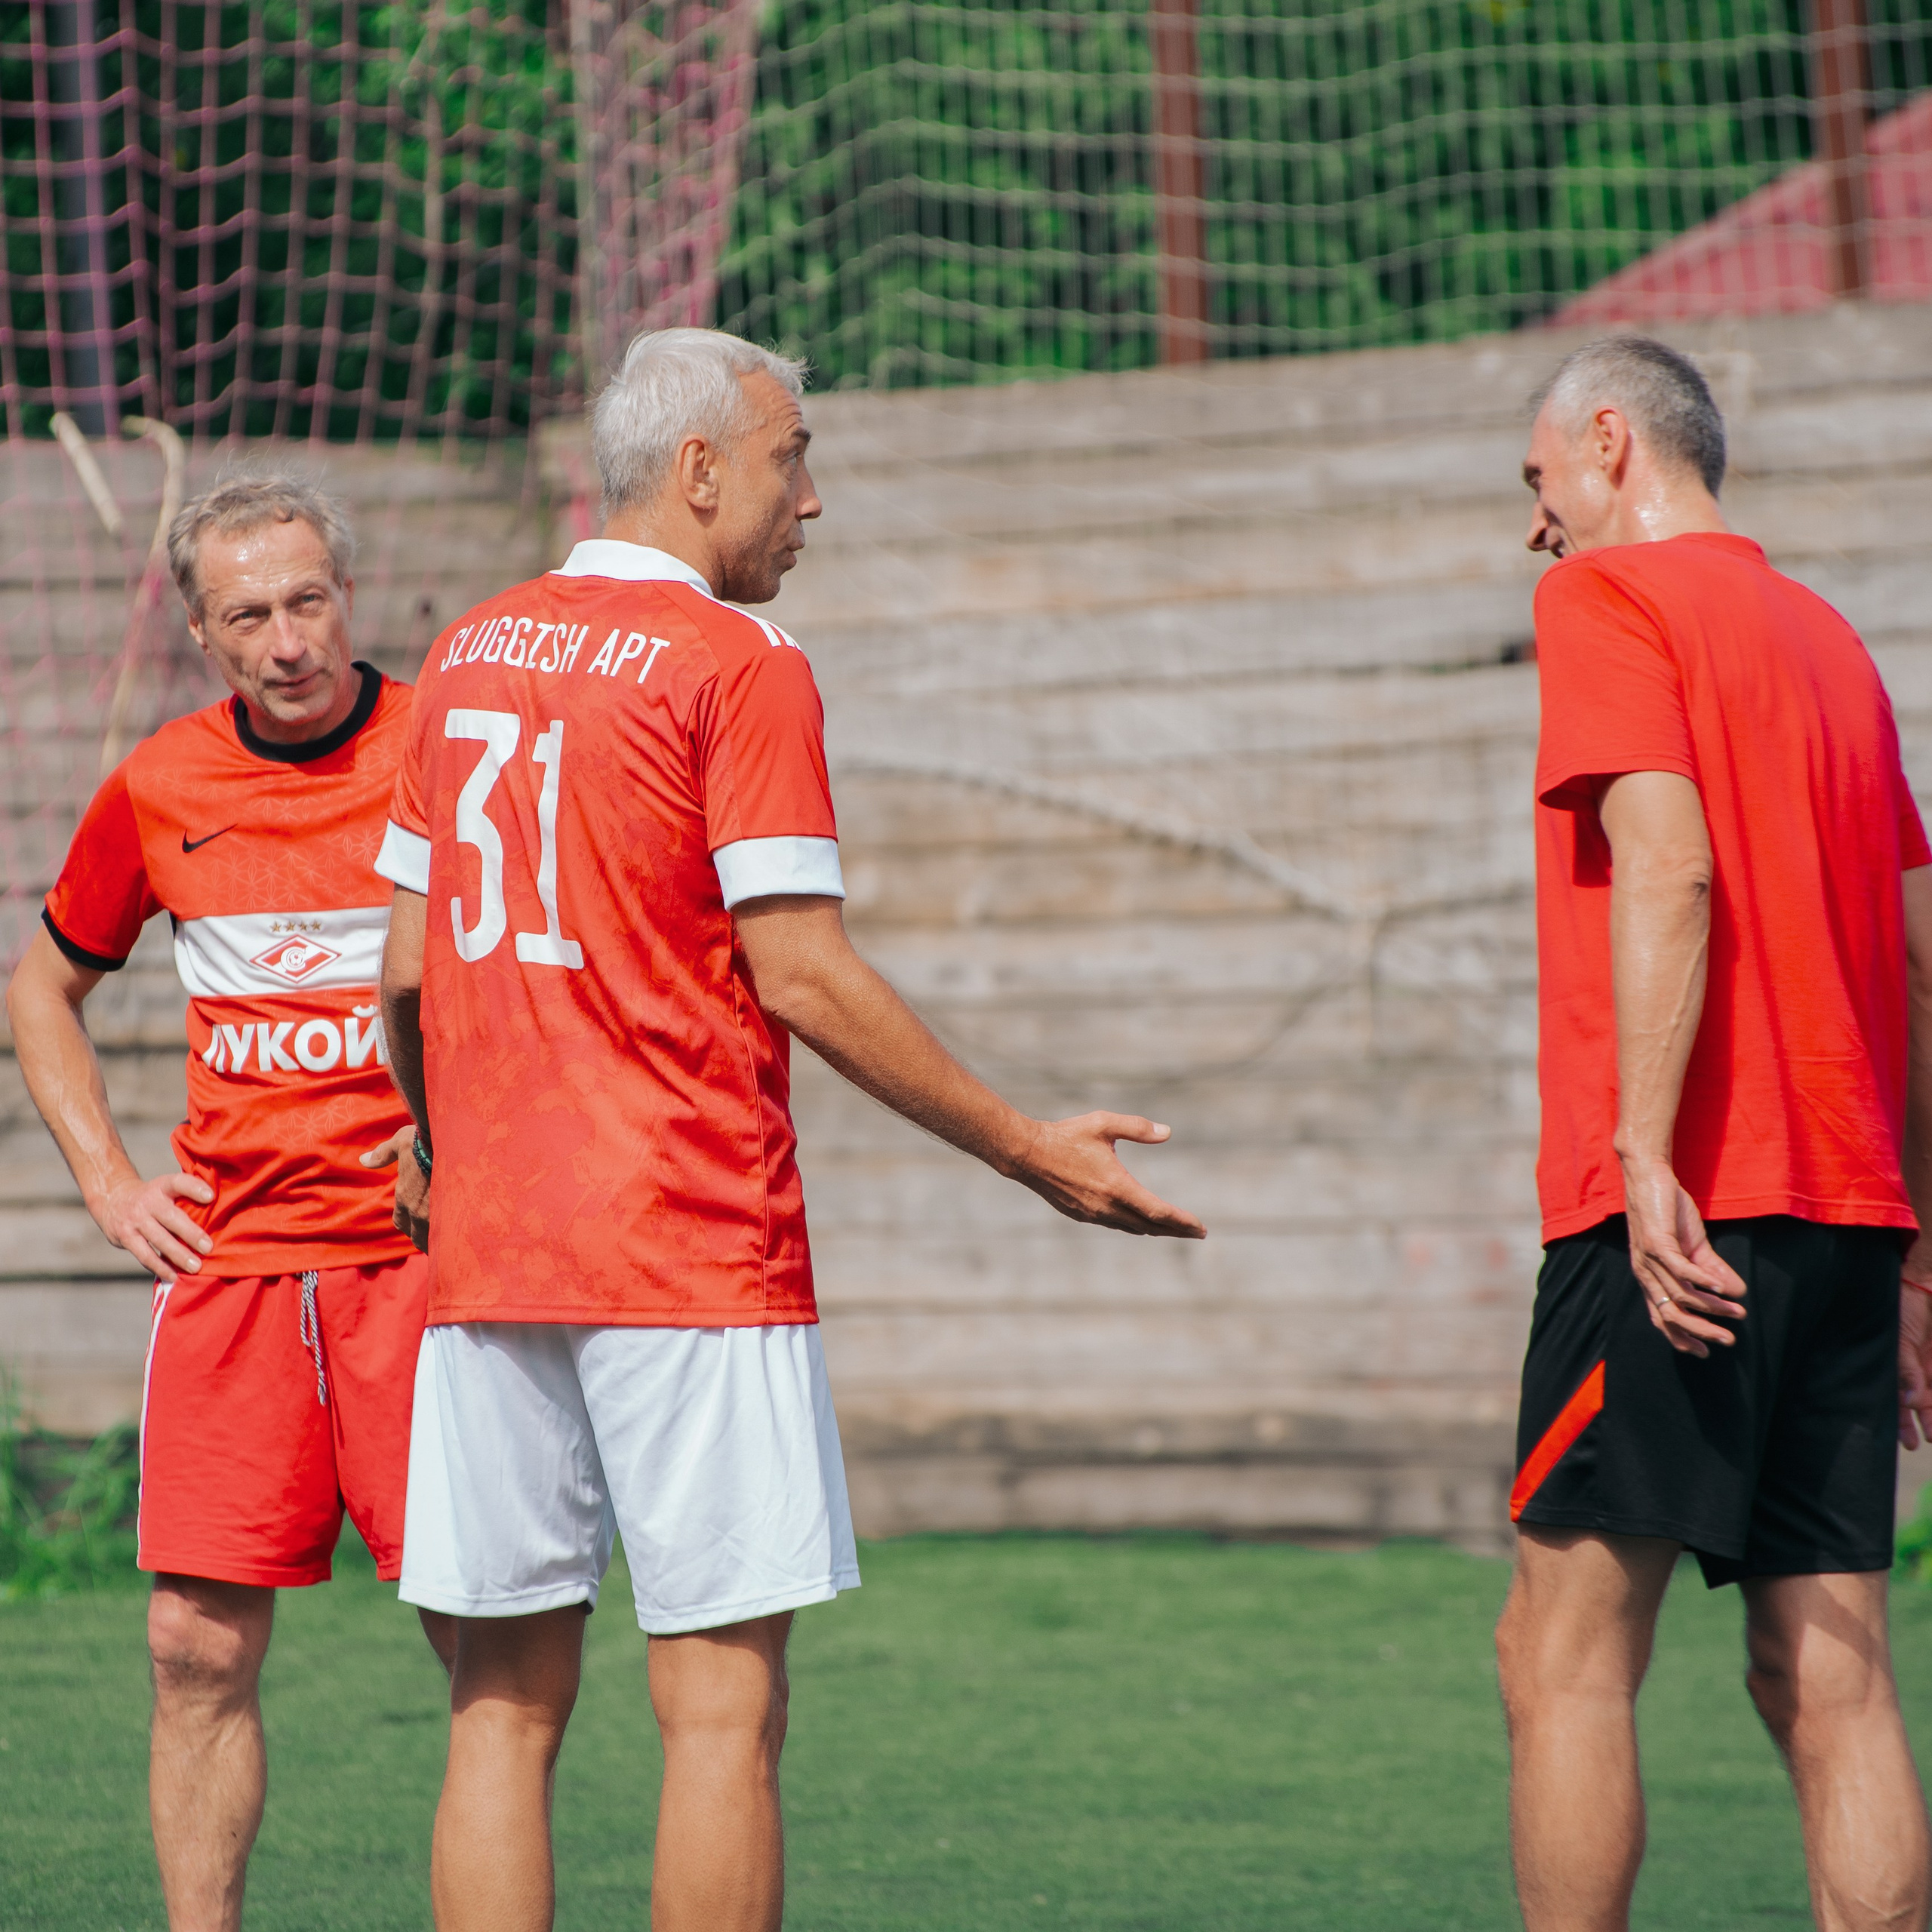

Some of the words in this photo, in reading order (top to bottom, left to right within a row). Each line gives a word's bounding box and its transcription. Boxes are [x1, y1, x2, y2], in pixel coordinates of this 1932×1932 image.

[440, 616, 589, 673] SLUGGISH
[586, 629, 671, 684] APT
[445, 708, 584, 970] 31
